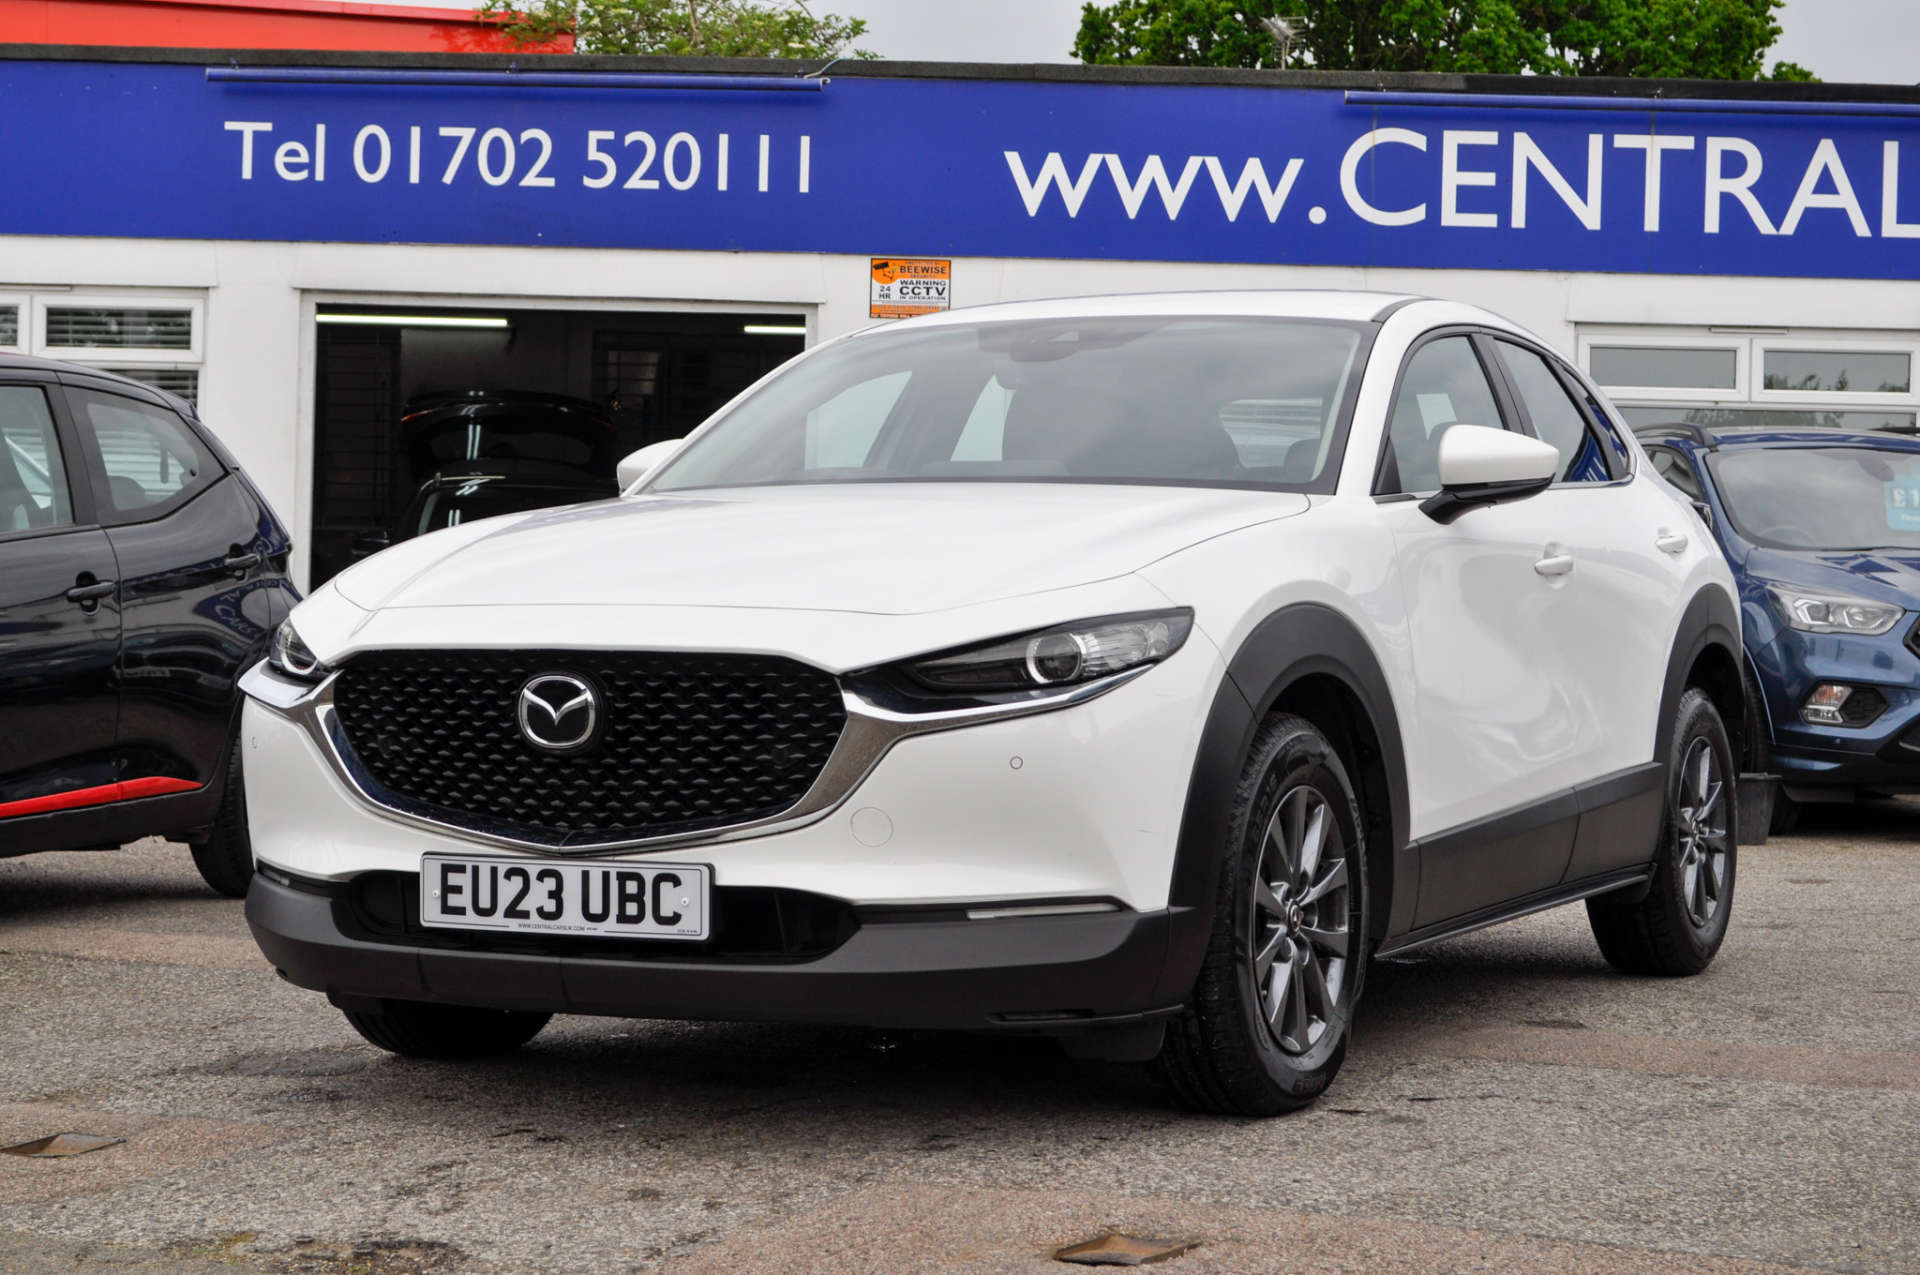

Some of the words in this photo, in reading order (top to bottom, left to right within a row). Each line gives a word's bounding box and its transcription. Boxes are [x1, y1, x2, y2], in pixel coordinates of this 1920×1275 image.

[224, 121, 326, 182] Tel
[353, 124, 556, 187] 01702
[583, 130, 811, 193] 520111
[899, 265, 947, 274] BEEWISE
[879, 292, 891, 300] HR
[899, 286, 946, 296] CCTV
[440, 863, 565, 921] EU23
[580, 869, 683, 926] UBC
